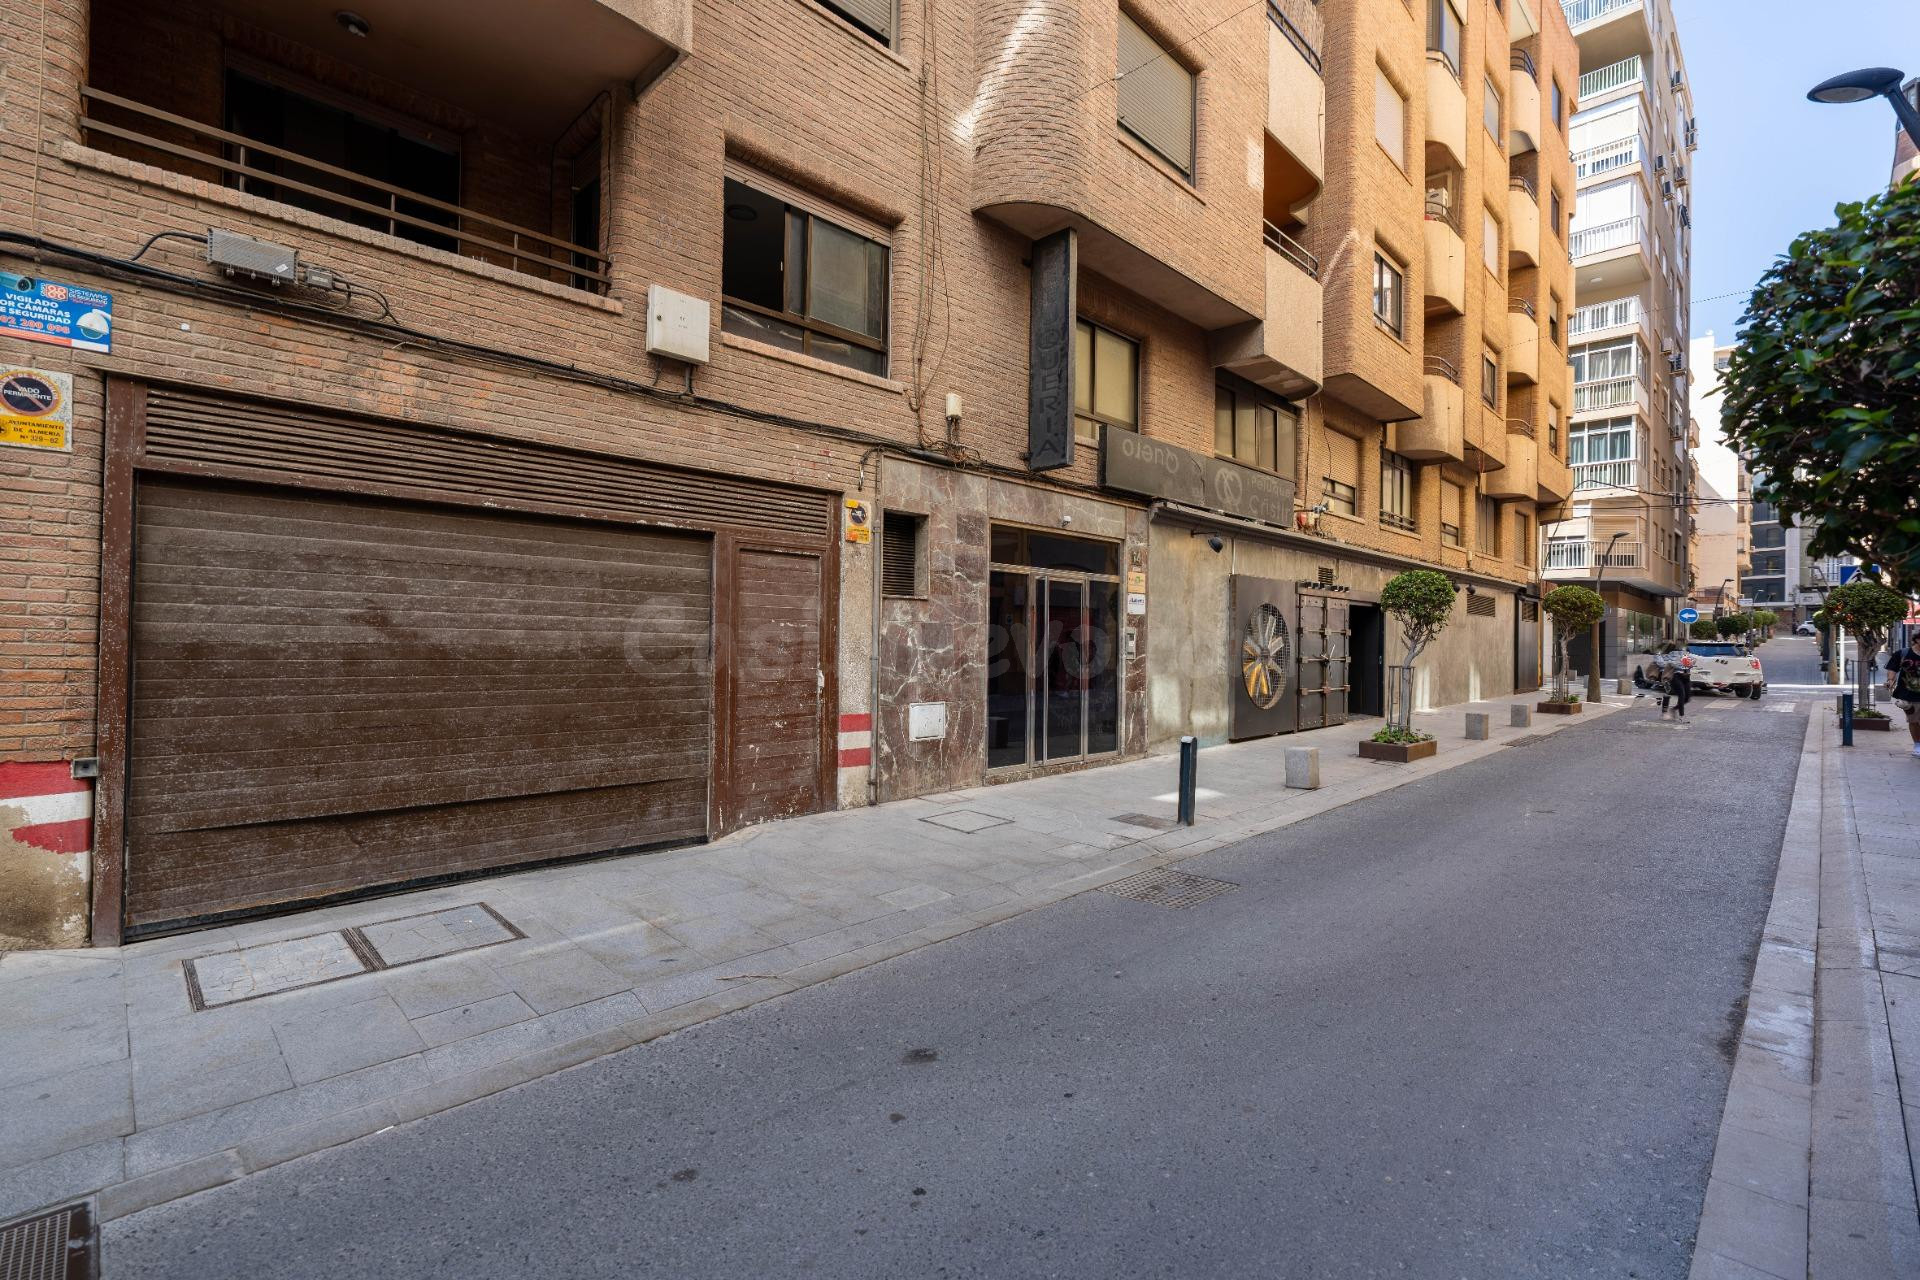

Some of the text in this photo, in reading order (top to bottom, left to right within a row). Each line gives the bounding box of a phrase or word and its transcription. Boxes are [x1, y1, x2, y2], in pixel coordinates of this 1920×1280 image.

[5, 293, 59, 309] VIGILADO
[9, 307, 71, 325] SEGURIDAD
[17, 302, 71, 318] CÁMARAS
[3, 389, 52, 401] PERMANENTE
[18, 386, 40, 394] VADO
[8, 419, 64, 431] AYUNTAMIENTO
